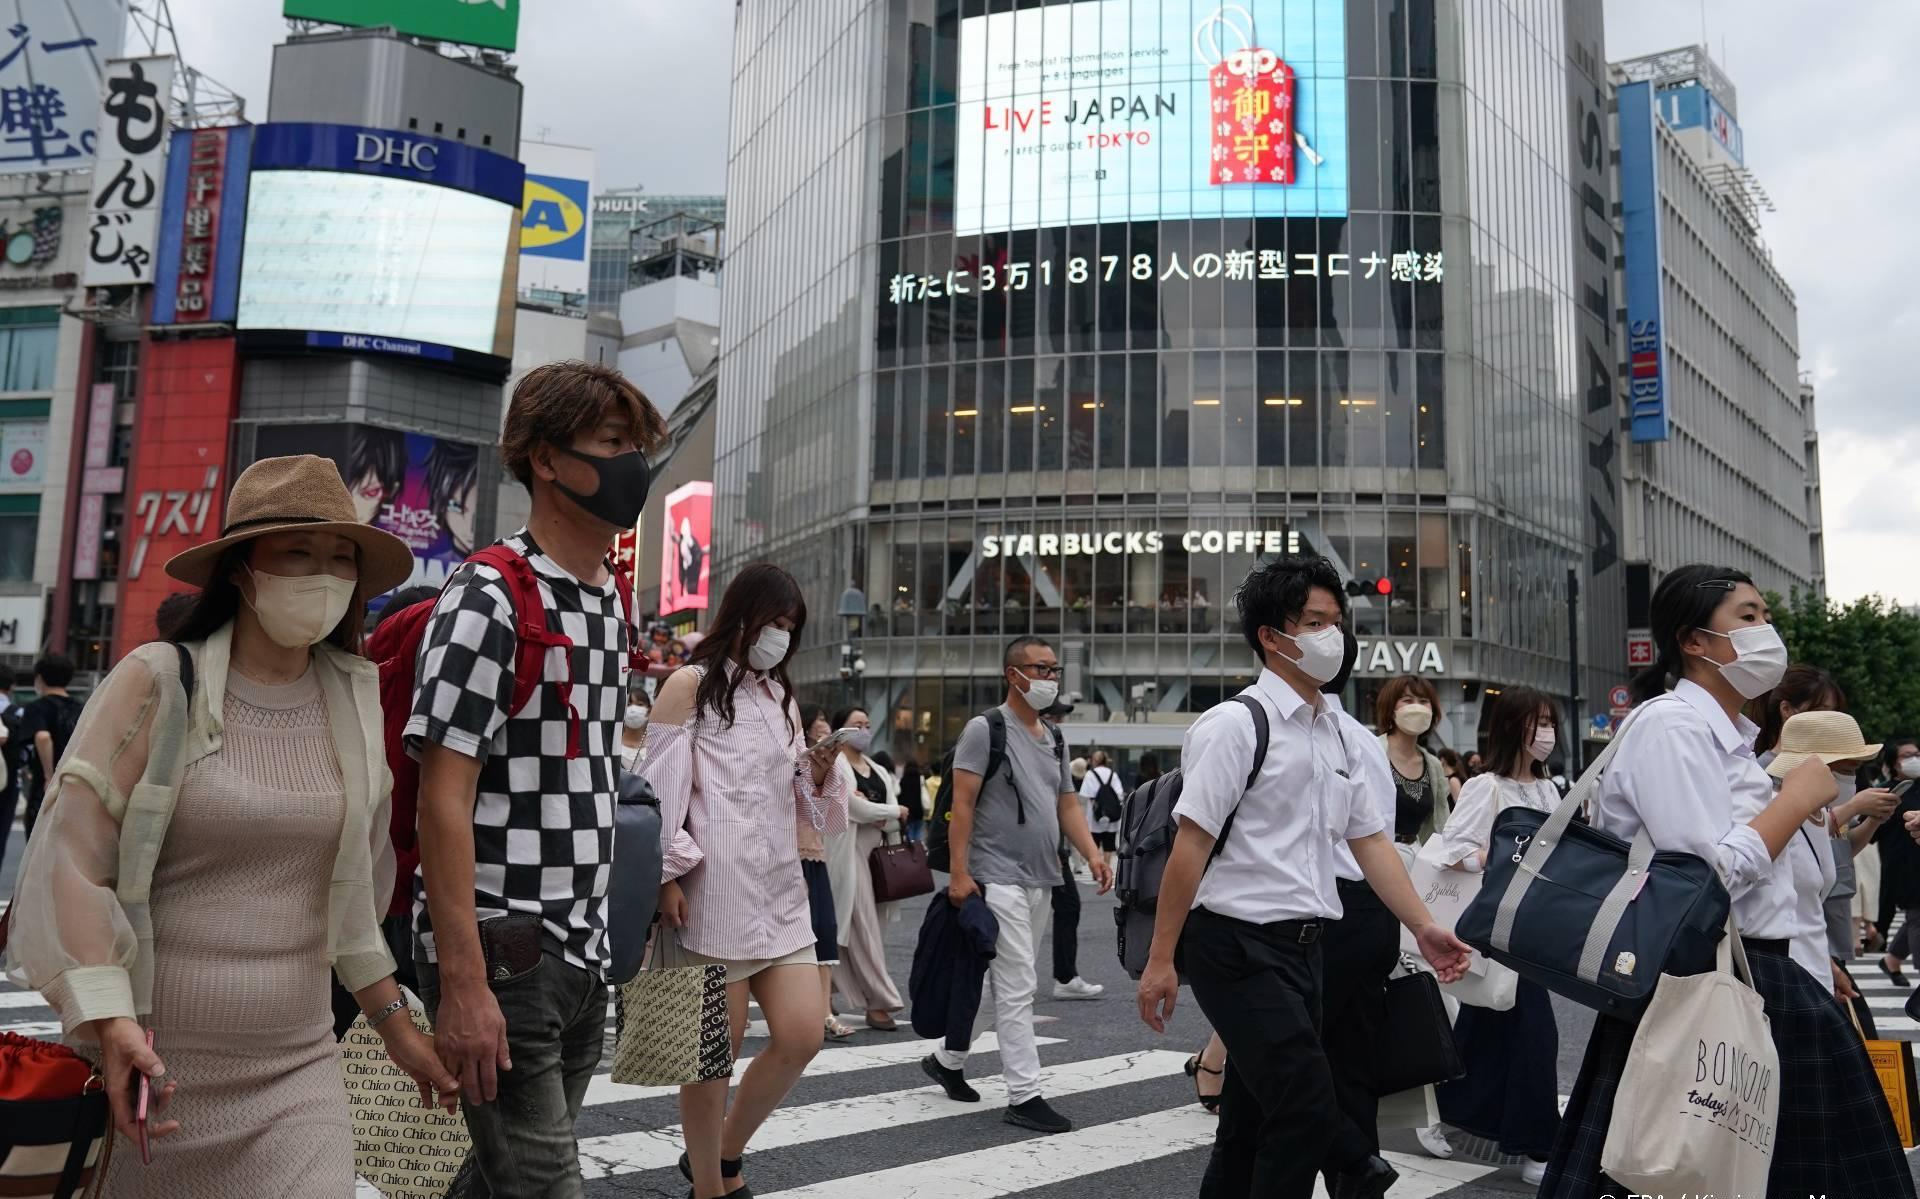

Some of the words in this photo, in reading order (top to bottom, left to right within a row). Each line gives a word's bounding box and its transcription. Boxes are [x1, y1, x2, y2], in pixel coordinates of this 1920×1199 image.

[998, 62, 1021, 72] Free
[1024, 56, 1057, 69] Tourist
[1129, 46, 1170, 58] ervice
[985, 101, 1052, 133] LIVE
[1064, 92, 1177, 125] JAPAN
[1231, 87, 1270, 166] 御守
[1087, 131, 1151, 149] TOKYO
[355, 133, 439, 171] DHC
[1004, 145, 1047, 156] PRFECT
[90, 62, 165, 278] もんじゃ
[600, 199, 649, 213] HULIC
[342, 335, 371, 348] DHC
[372, 338, 421, 355] Channel
[1631, 320, 1660, 418] SEIBU
[127, 464, 219, 580] クスリ
[982, 530, 1163, 558] STARBUCKS
[1182, 530, 1300, 554] COFFEE
[1352, 641, 1444, 673] TAYA
[1632, 643, 1649, 661] 本
[350, 1033, 383, 1046] Chico
[346, 1063, 378, 1075] Chico
[1695, 1038, 1771, 1115] BONSOIR
[361, 1079, 391, 1091] Chico
[374, 1094, 405, 1107] Chico
[1687, 1089, 1729, 1118] today's
[355, 1109, 385, 1121] Chico
[388, 1110, 420, 1124] Chico
[424, 1113, 457, 1127] Chico
[368, 1125, 399, 1138] Chico
[402, 1127, 437, 1141] Chico
[440, 1130, 470, 1143] Chico
[384, 1141, 415, 1155] Chico
[419, 1144, 451, 1157] Chico
[366, 1156, 395, 1169] Chico
[398, 1158, 430, 1172] Chico
[381, 1172, 410, 1186] Chico
[413, 1175, 445, 1189] Chico
